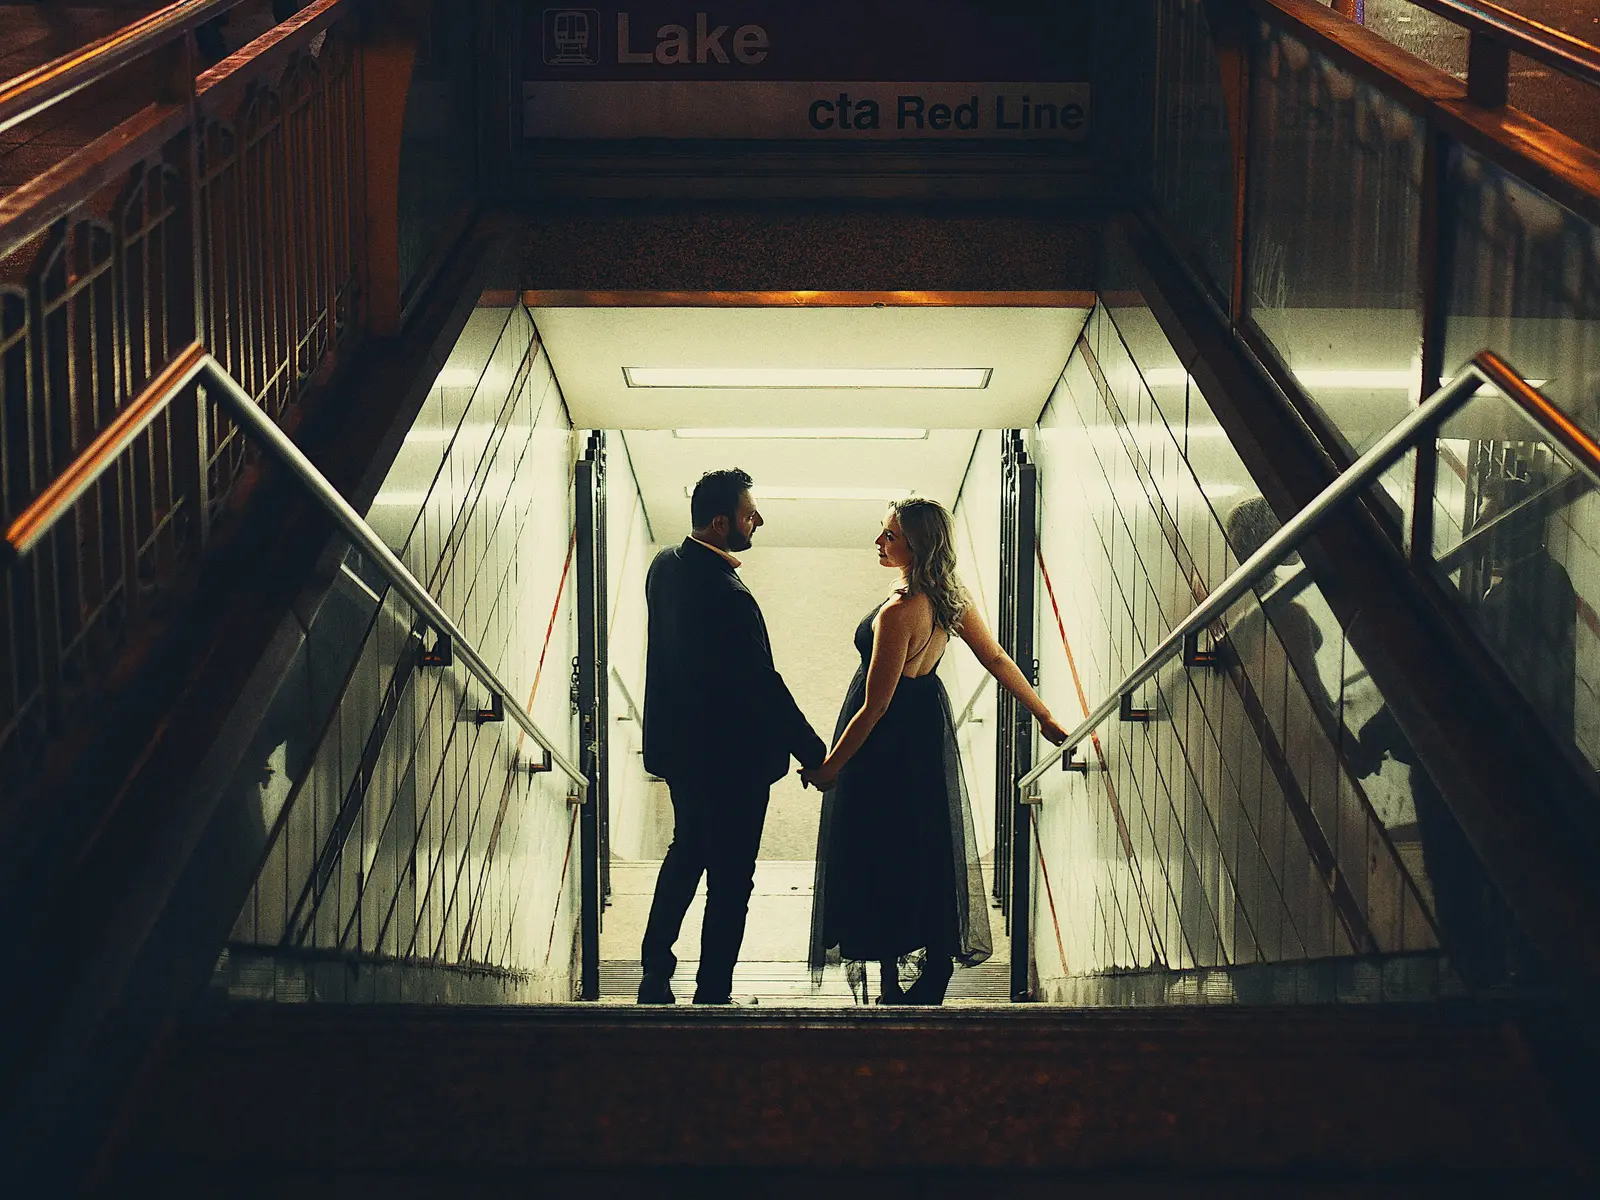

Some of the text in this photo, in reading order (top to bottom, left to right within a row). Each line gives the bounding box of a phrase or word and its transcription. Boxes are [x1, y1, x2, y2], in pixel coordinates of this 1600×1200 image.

[616, 12, 771, 65] Lake
[807, 93, 1085, 131] cta Red Line
